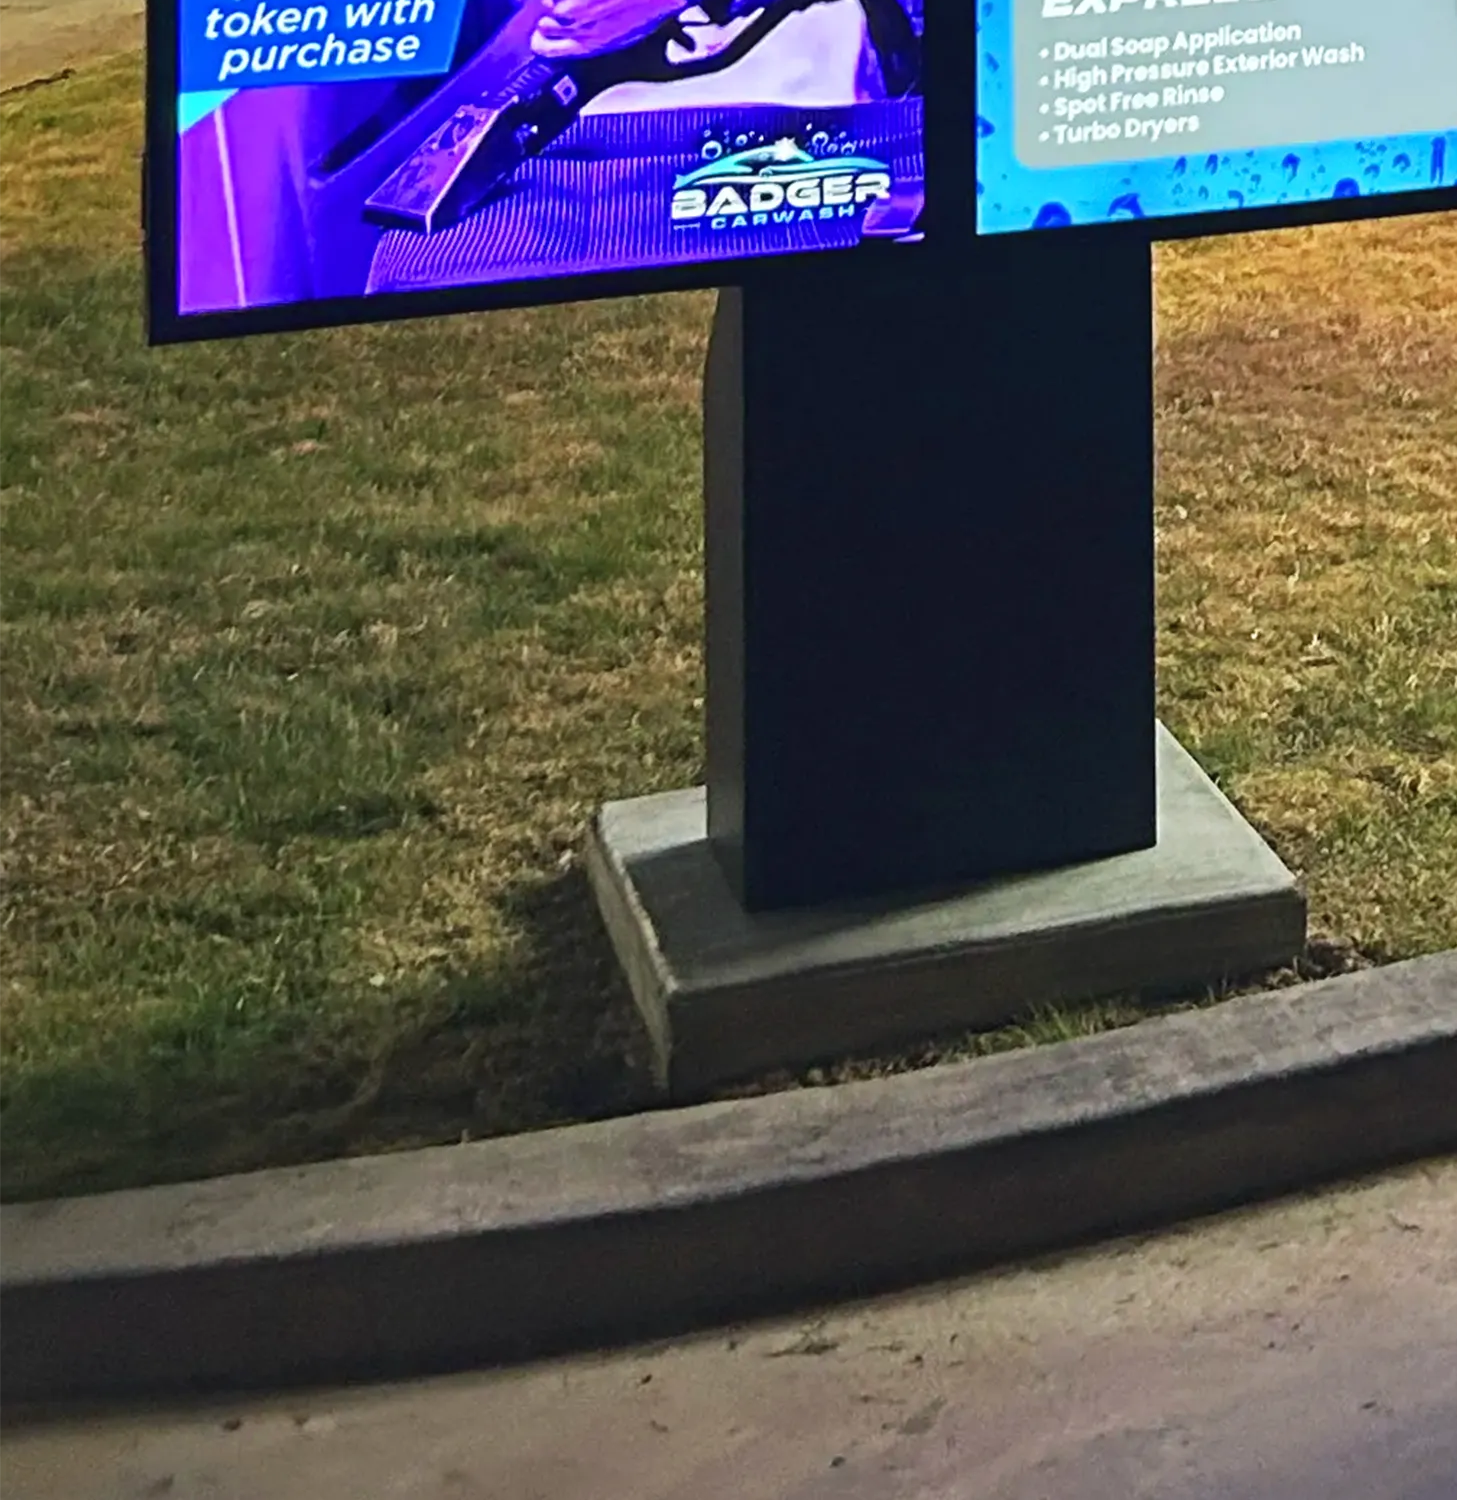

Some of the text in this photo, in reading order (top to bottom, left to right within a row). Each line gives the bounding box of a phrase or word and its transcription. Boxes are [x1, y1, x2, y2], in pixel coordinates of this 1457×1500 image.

[204, 2, 328, 40] token
[217, 33, 421, 82] purchase
[1053, 21, 1302, 62] Dual Soap Application
[1053, 41, 1366, 93] High Pressure Exterior Wash
[1053, 83, 1225, 121] Spot Free Rinse
[1053, 113, 1200, 145] Turbo Dryers
[671, 173, 891, 220] BADGER
[711, 205, 855, 230] CARWASH
